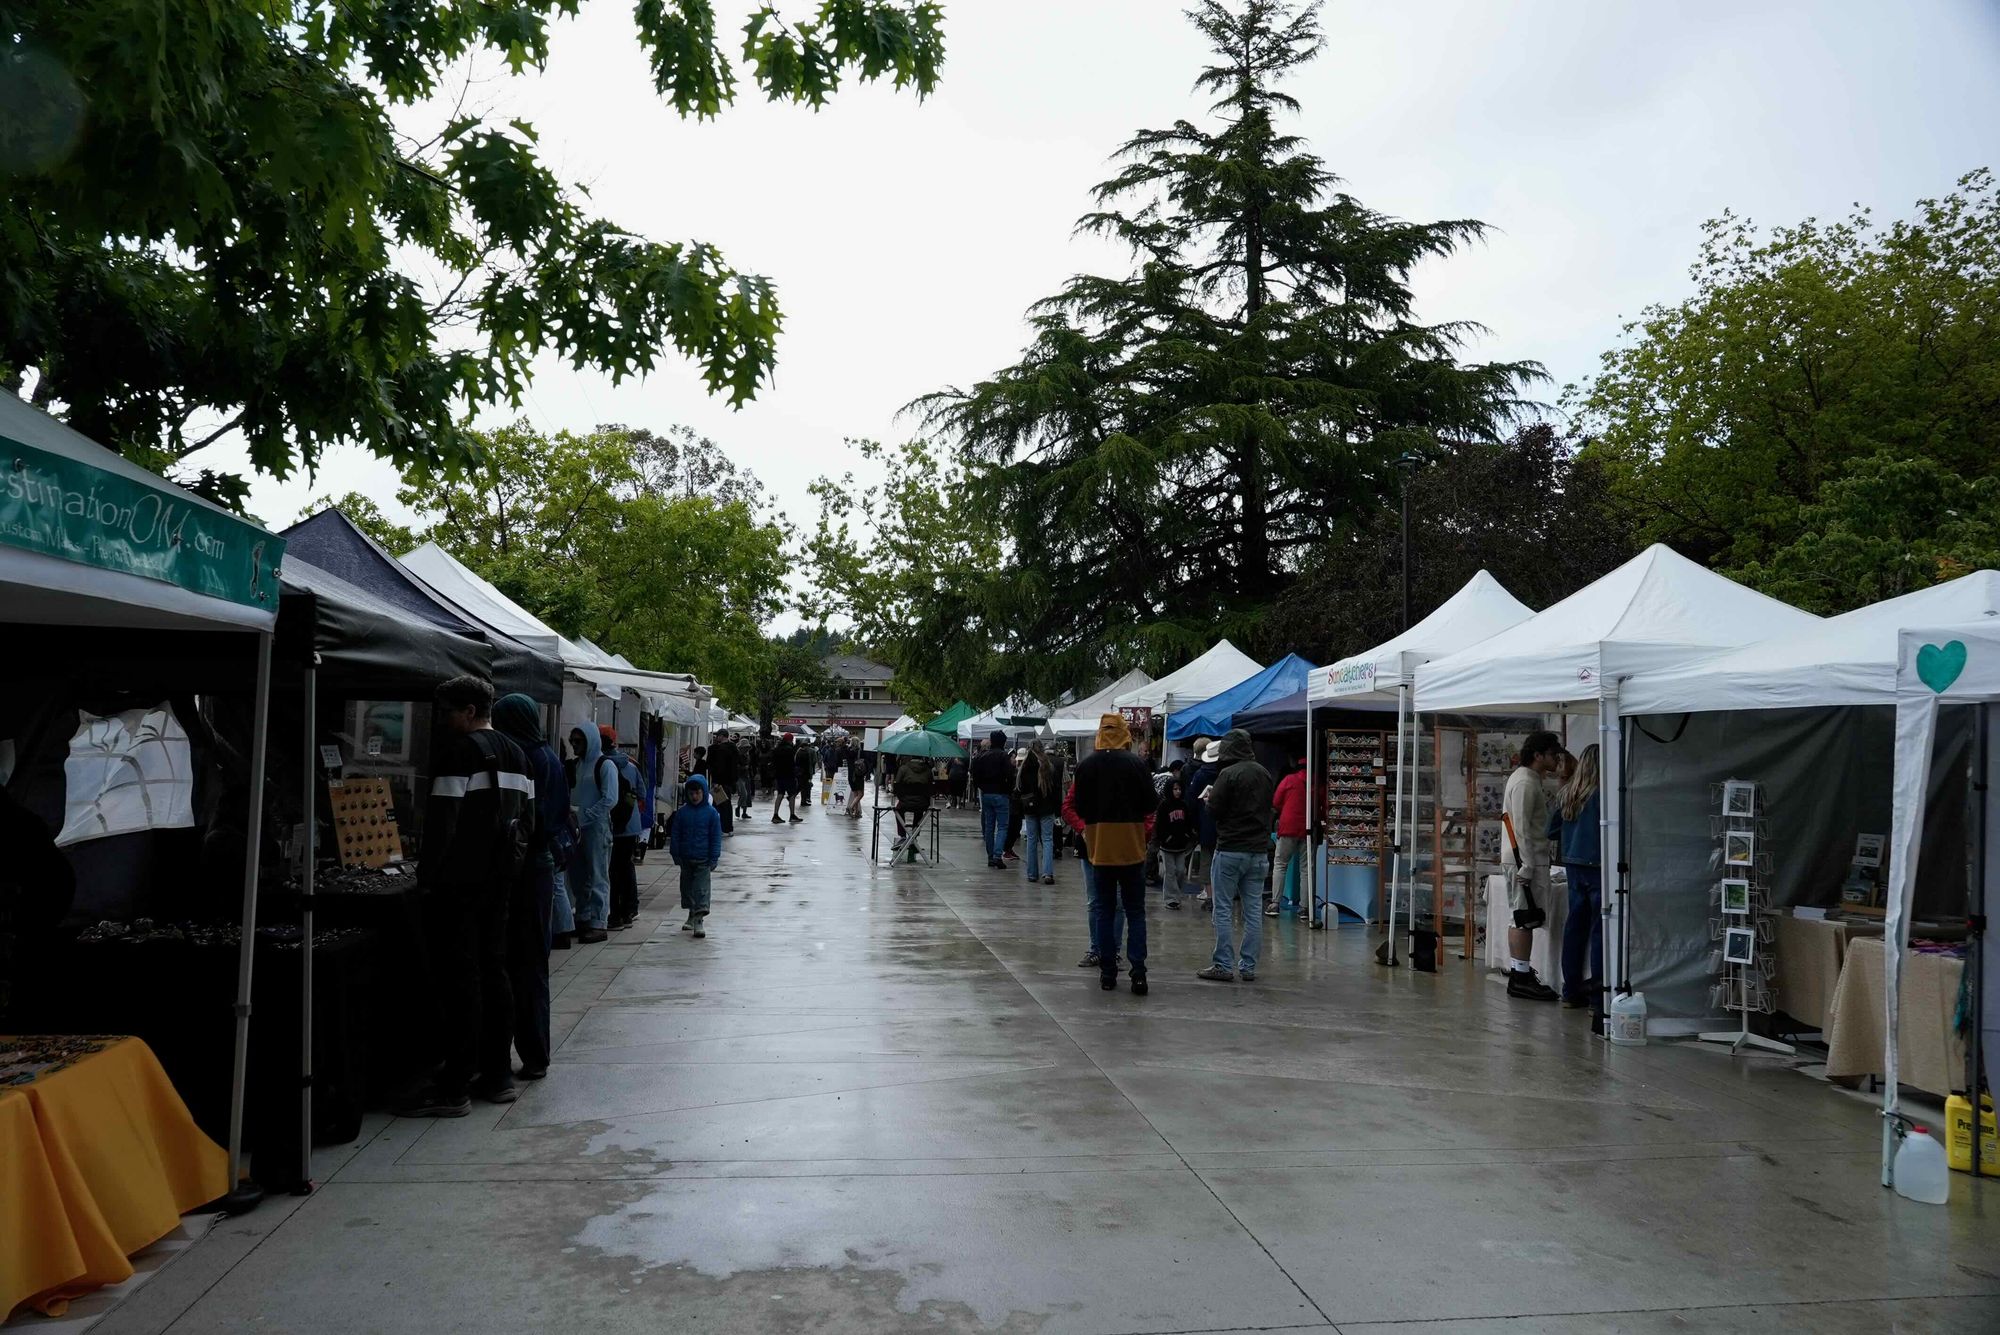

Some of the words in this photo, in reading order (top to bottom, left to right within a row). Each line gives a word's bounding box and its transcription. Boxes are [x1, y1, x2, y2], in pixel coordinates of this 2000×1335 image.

[0, 467, 225, 561] stinationOM.com
[0, 518, 43, 543] ustom
[1327, 661, 1374, 685] Suncatchers
[1957, 1118, 1995, 1135] Preone
